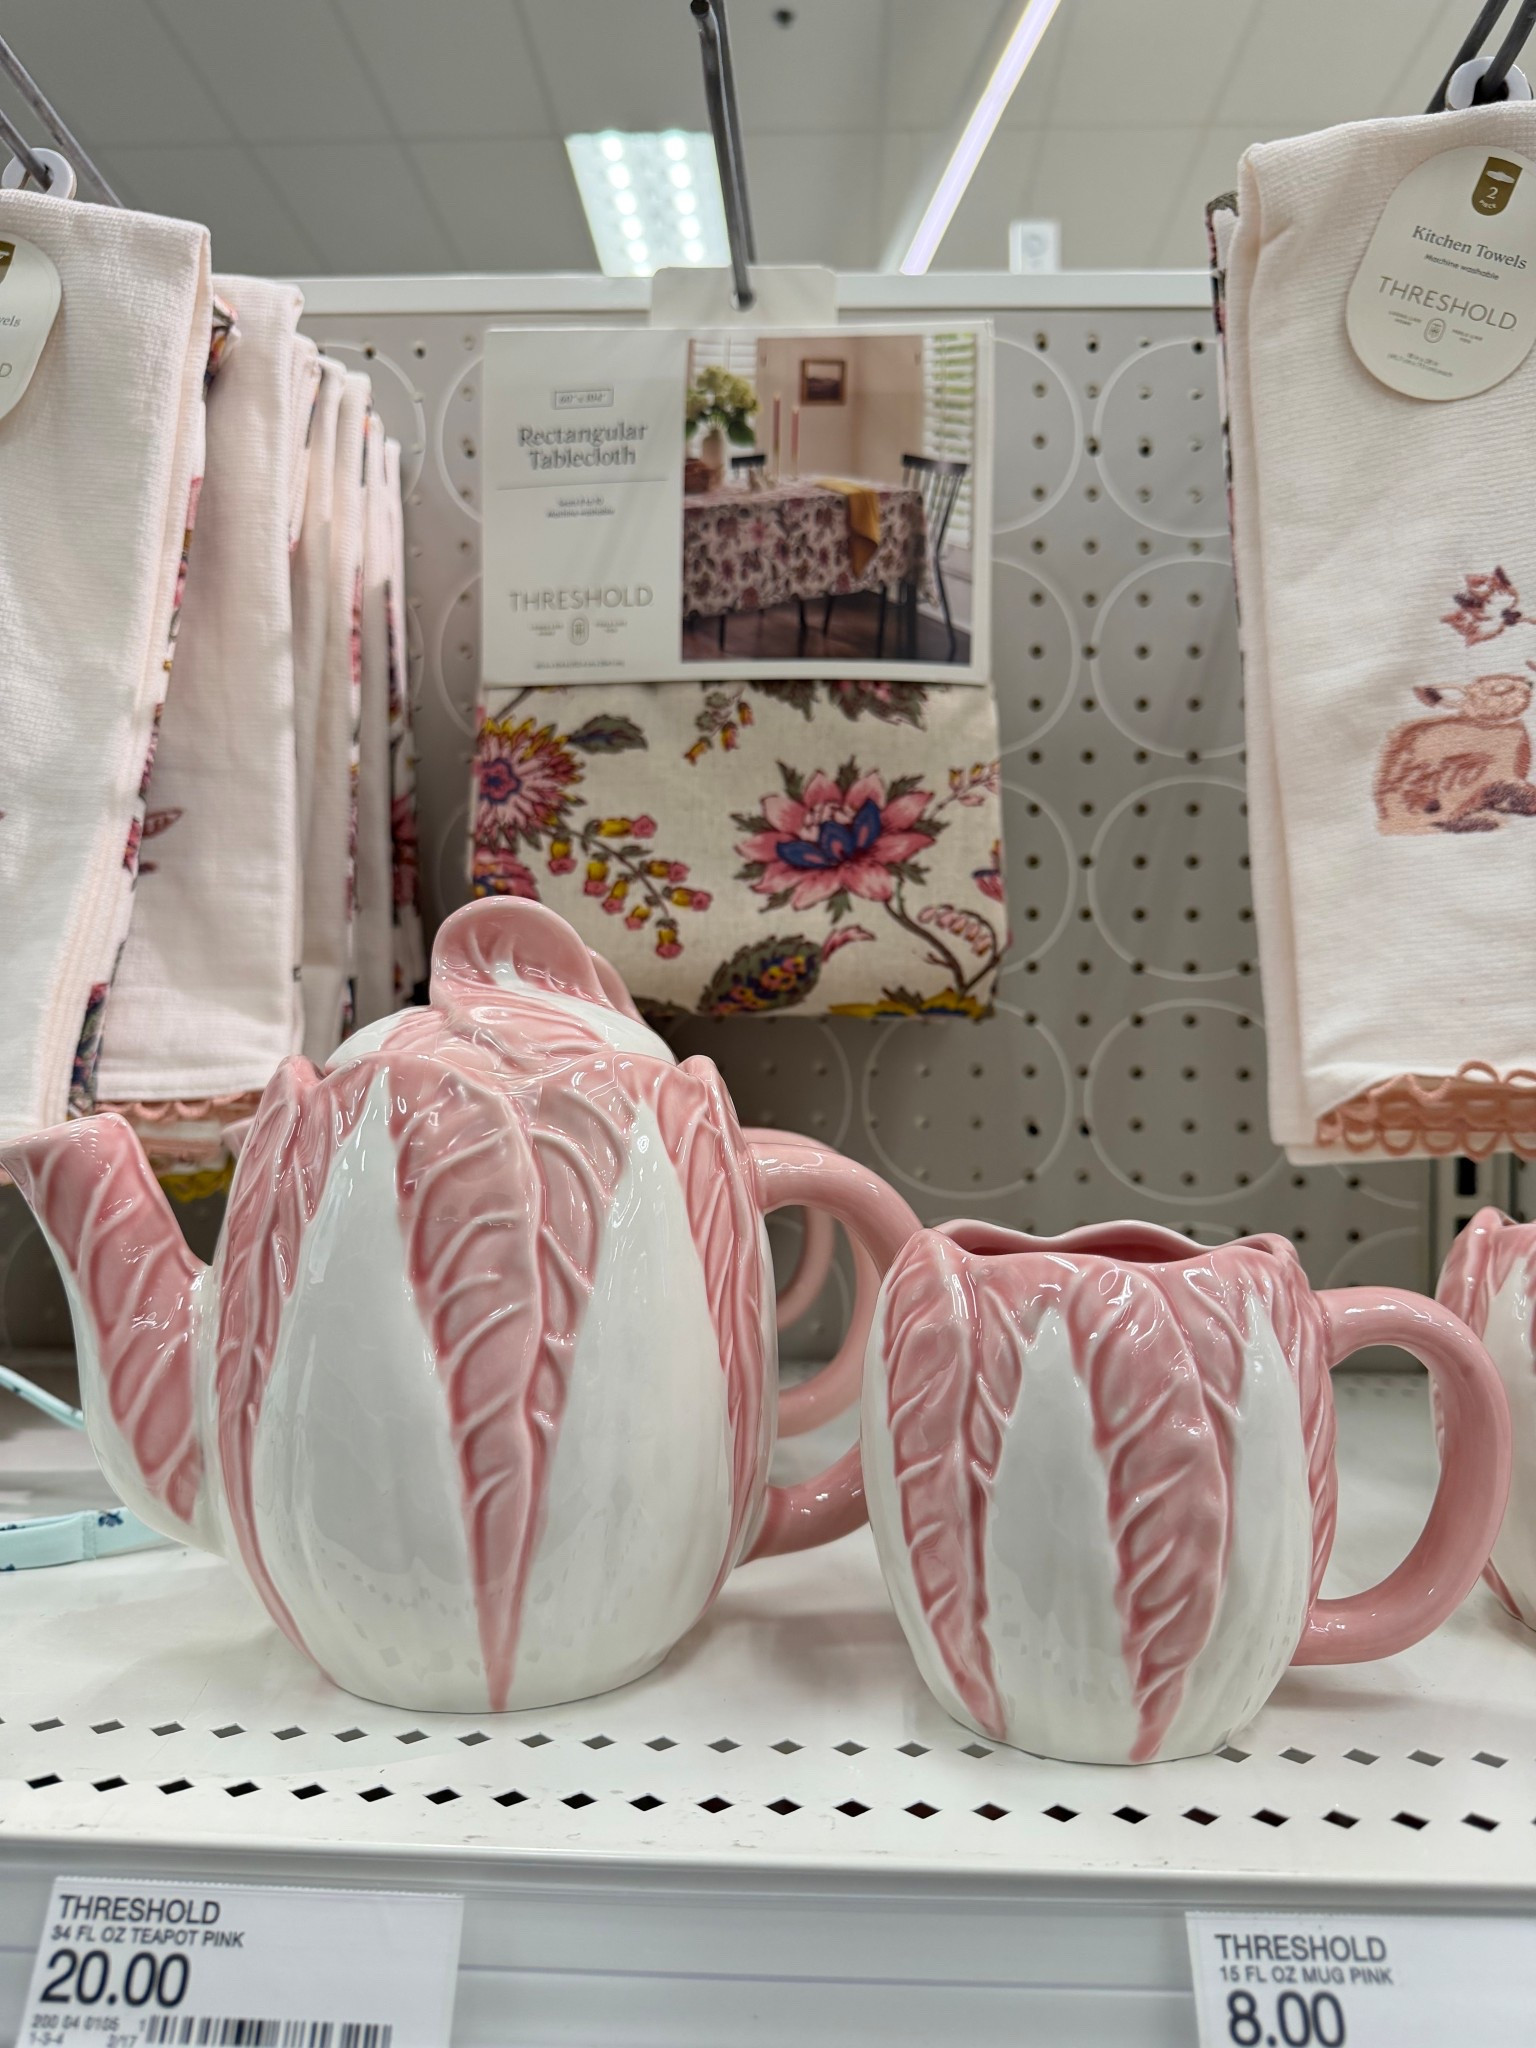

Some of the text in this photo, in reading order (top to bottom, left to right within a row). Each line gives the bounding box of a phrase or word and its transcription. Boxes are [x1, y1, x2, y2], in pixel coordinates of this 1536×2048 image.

[1486, 187, 1498, 199] 2
[1412, 225, 1527, 270] Kitchen Towels
[1378, 275, 1517, 330] THRESHOLD
[517, 422, 648, 447] Rectangular
[529, 446, 636, 470] Tablecloth
[509, 584, 654, 611] THRESHOLD
[60, 1894, 220, 1925] THRESHOLD
[51, 1924, 245, 1948] 34 FL OZ TEAPOT PINK
[1214, 1934, 1387, 1962] THRESHOLD
[39, 1948, 190, 2009] 20.00
[1220, 1965, 1394, 1986] 15 FL OZ MUG PINK
[1227, 1989, 1346, 2048] 8.00
